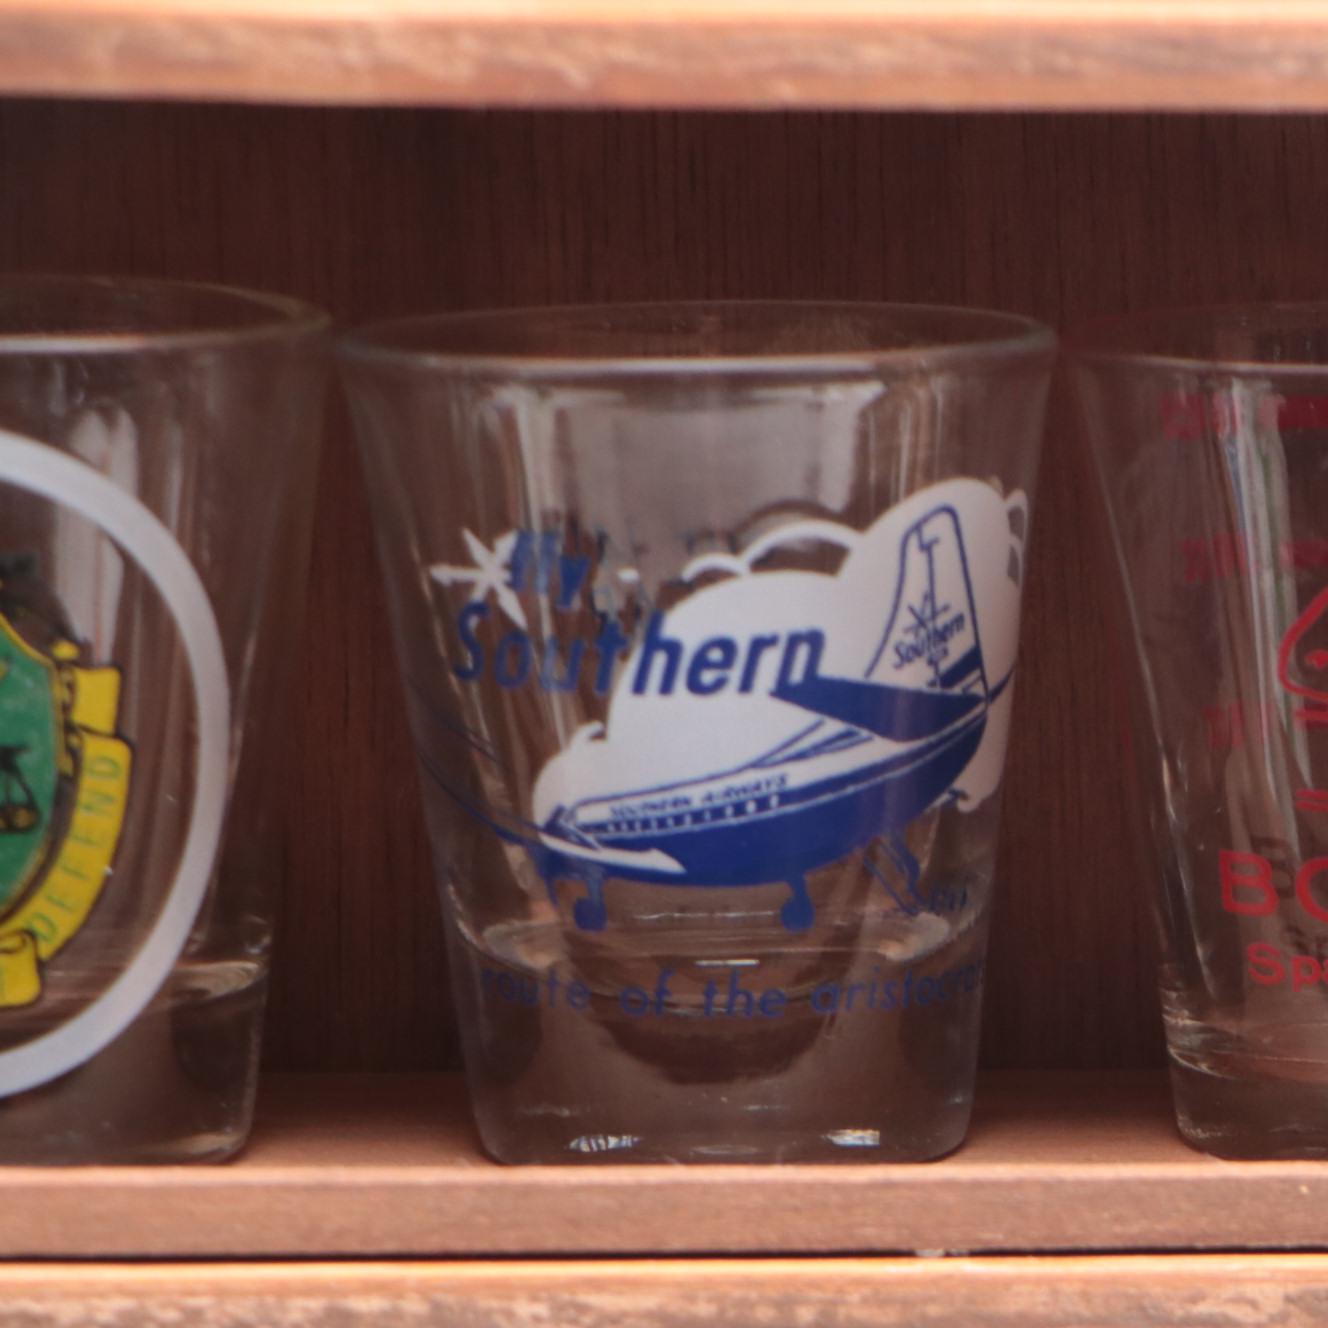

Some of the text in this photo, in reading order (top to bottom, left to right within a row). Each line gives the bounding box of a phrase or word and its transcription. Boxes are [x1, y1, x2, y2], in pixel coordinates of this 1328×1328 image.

[455, 601, 825, 697] Southern
[619, 967, 677, 1016] of
[702, 969, 788, 1019] the
